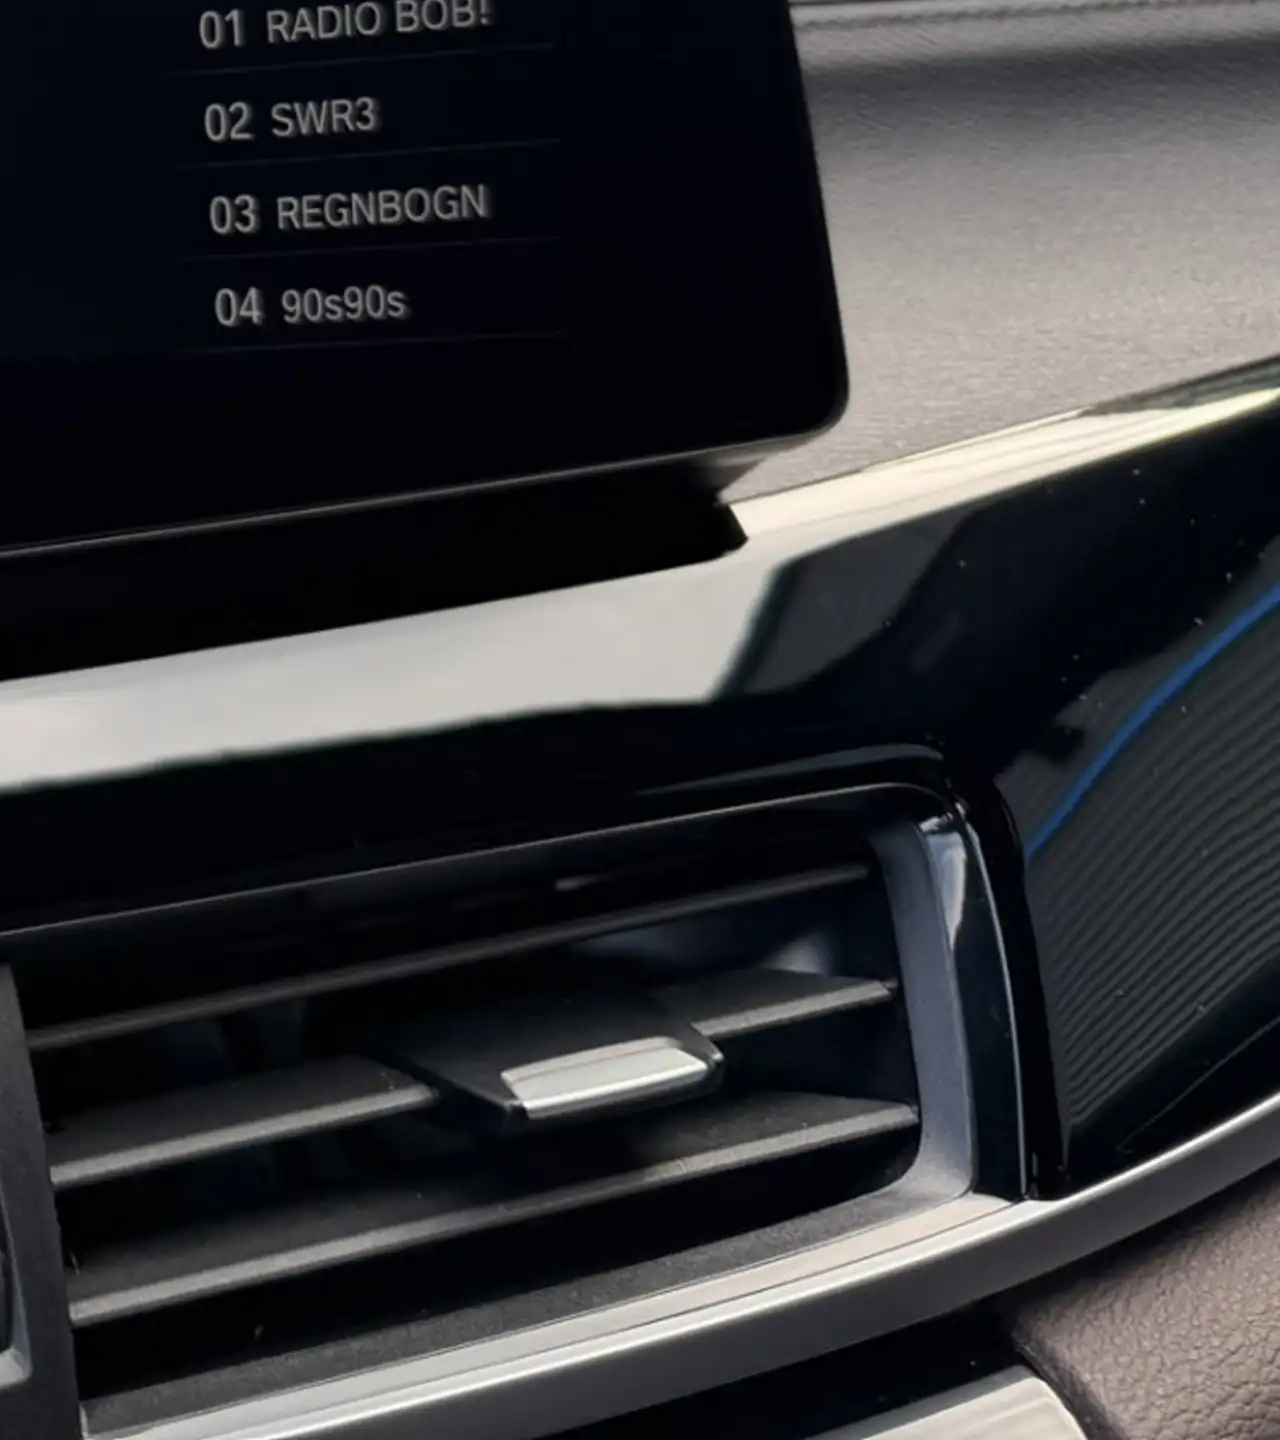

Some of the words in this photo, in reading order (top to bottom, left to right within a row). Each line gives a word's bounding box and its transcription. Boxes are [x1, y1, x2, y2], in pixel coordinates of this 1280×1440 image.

[199, 8, 243, 49] 01
[266, 1, 383, 43] RADIO
[204, 101, 254, 142] 02
[271, 96, 378, 137] SWR3
[208, 194, 258, 236] 03
[277, 184, 489, 229] REGNBOGN
[214, 287, 263, 327] 04
[281, 285, 408, 324] 90s90s
